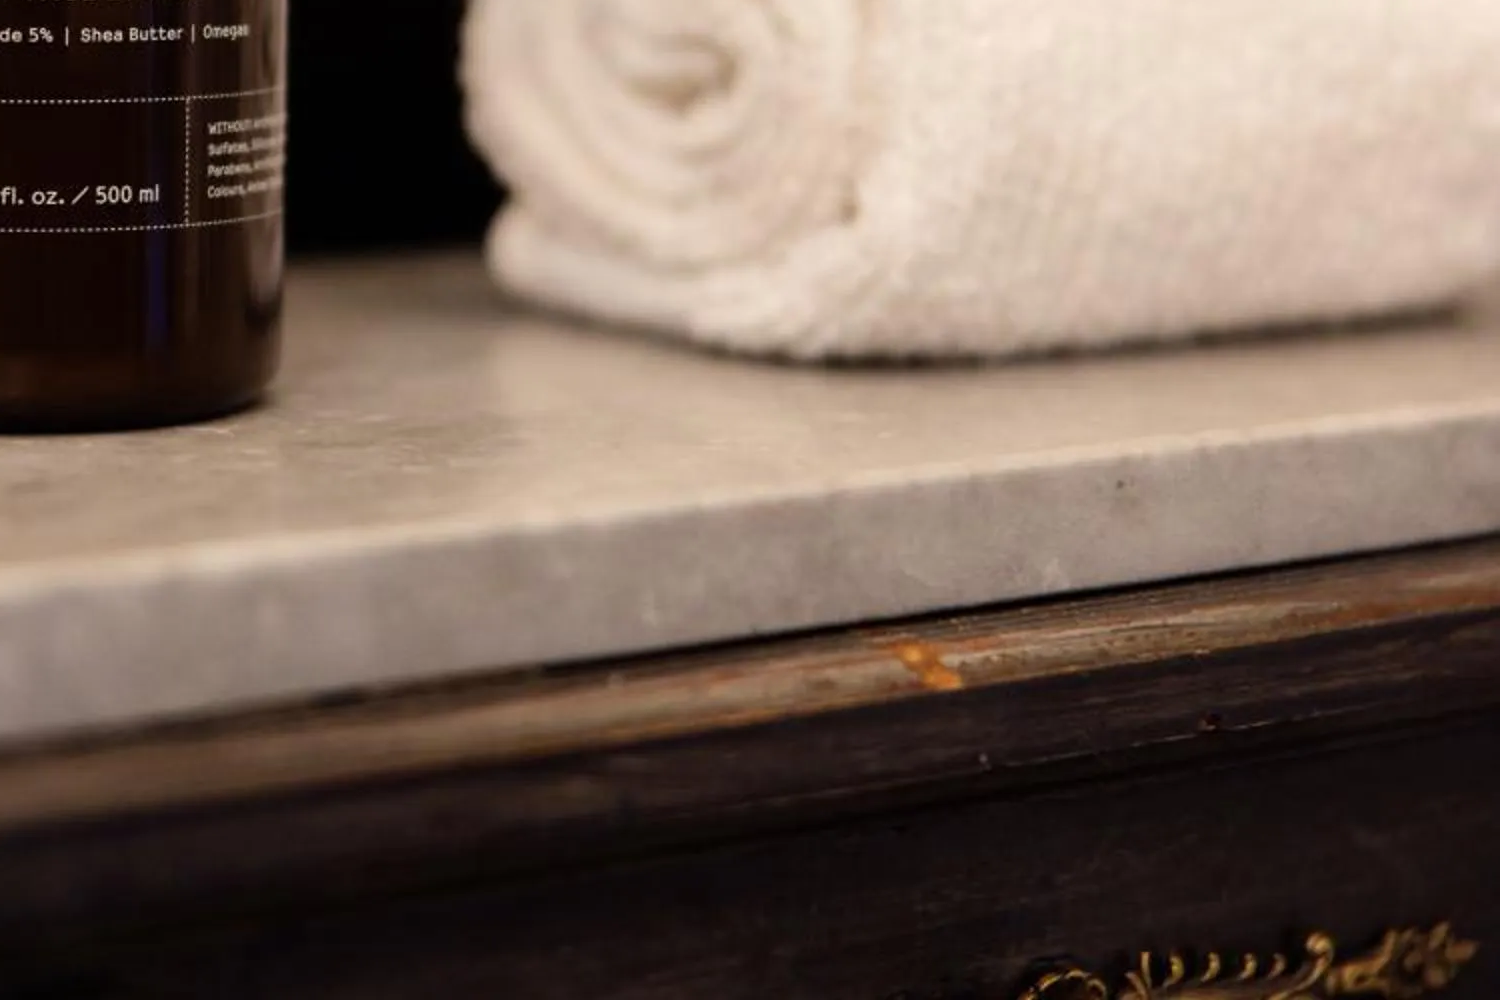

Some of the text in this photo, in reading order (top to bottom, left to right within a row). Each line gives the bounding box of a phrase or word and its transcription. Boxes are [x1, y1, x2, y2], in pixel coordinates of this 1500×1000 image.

[28, 27, 54, 43] 5%
[80, 27, 123, 43] Shea
[129, 27, 184, 41] Butter
[1, 186, 24, 204] fl.
[32, 188, 65, 205] oz.
[95, 185, 132, 203] 500
[139, 184, 160, 202] ml
